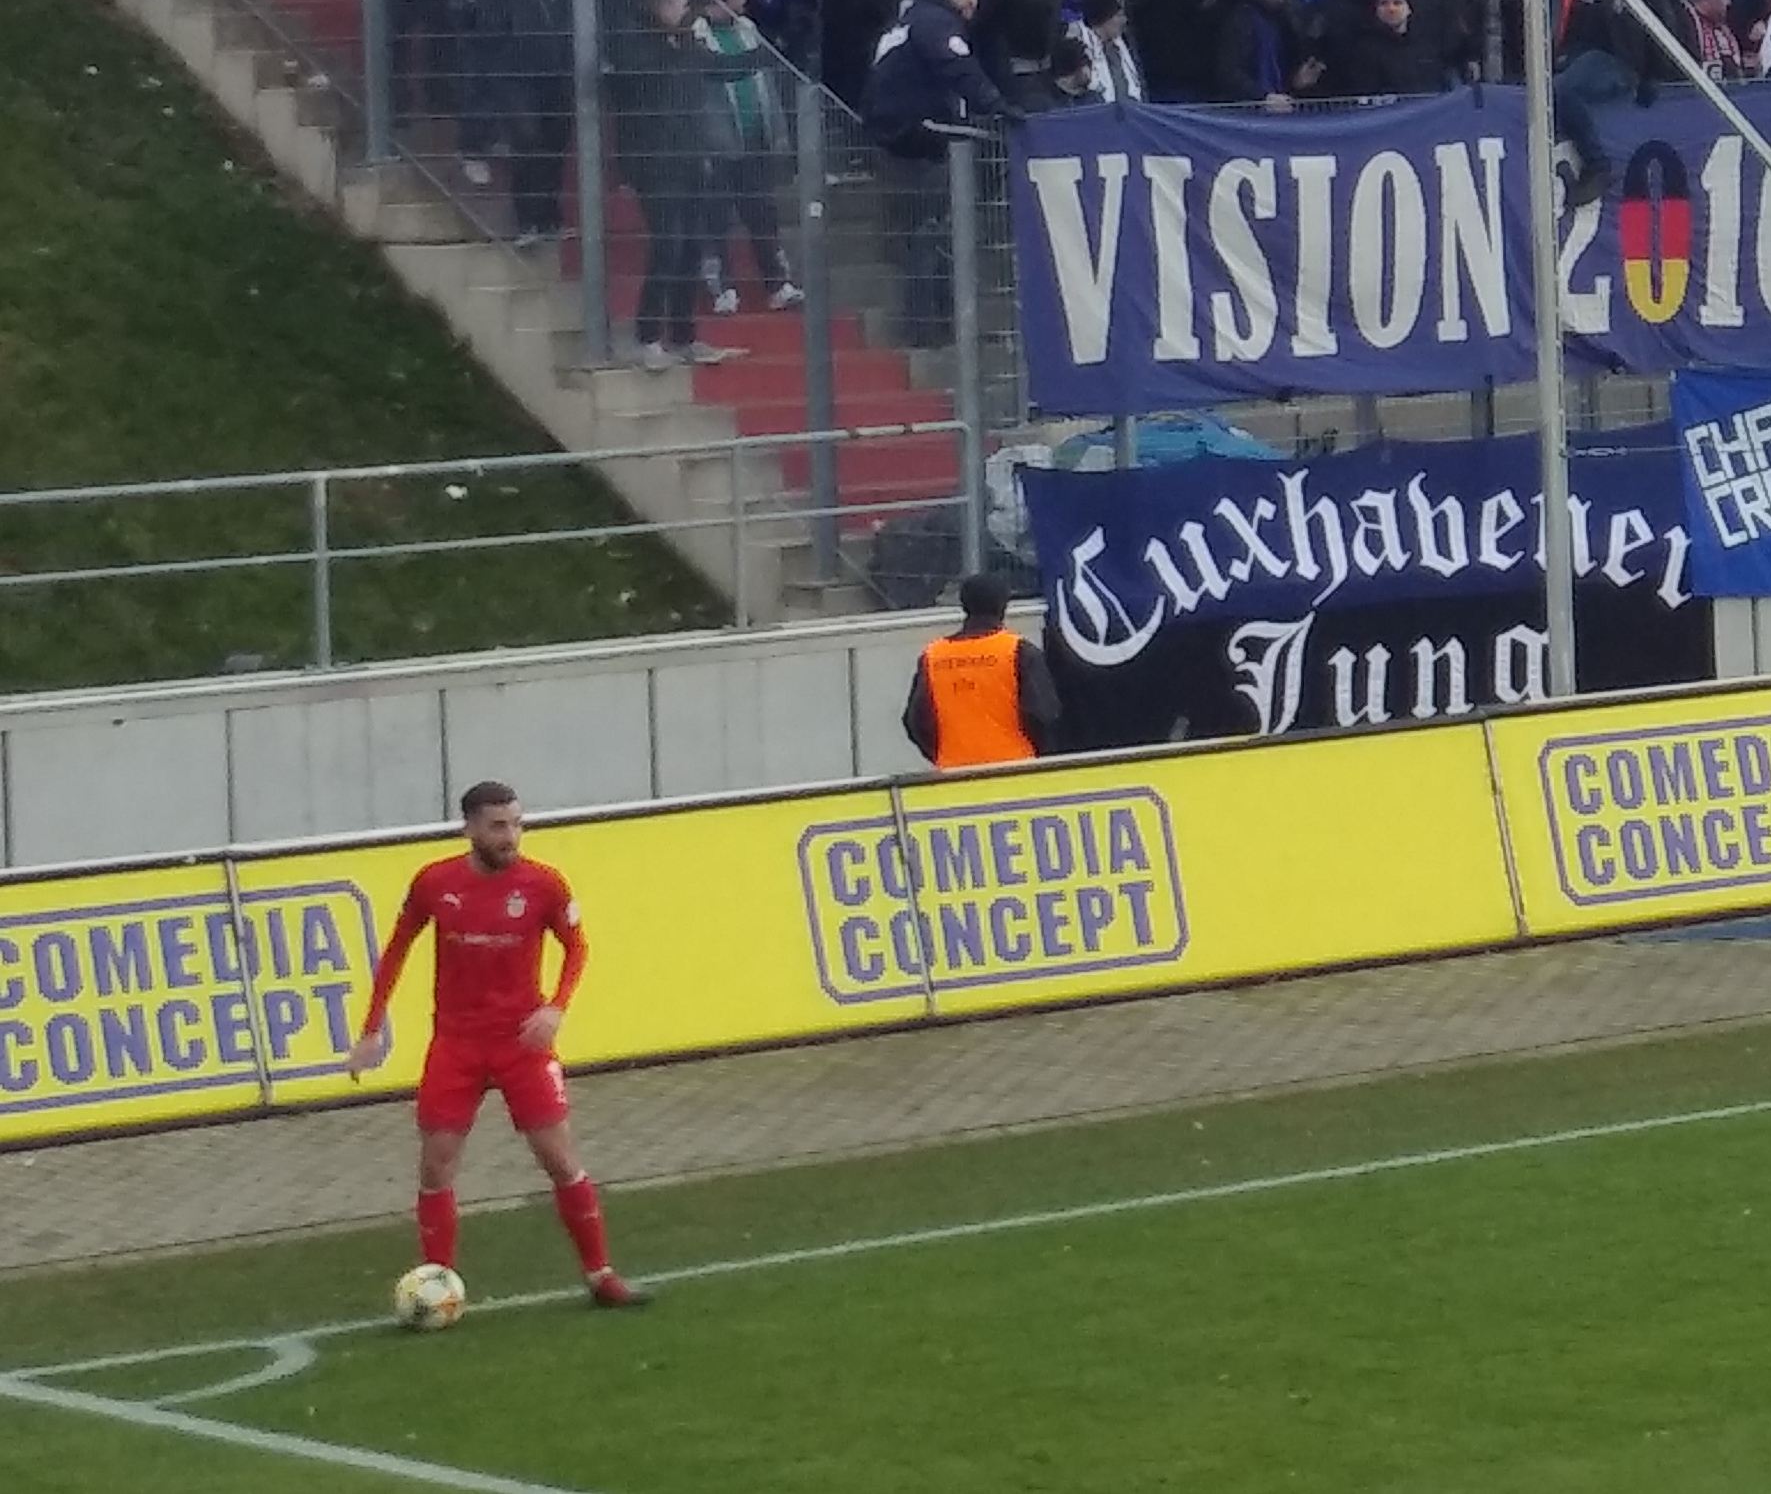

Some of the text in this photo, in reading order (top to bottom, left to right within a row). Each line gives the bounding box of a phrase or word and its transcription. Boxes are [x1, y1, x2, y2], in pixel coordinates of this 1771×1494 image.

[1026, 136, 1513, 366] VISION
[1056, 464, 1693, 668] Cuxhavener
[828, 806, 1149, 907] COMEDIA
[840, 880, 1157, 984] CONCEPT
[0, 981, 354, 1092] CONCEPT
